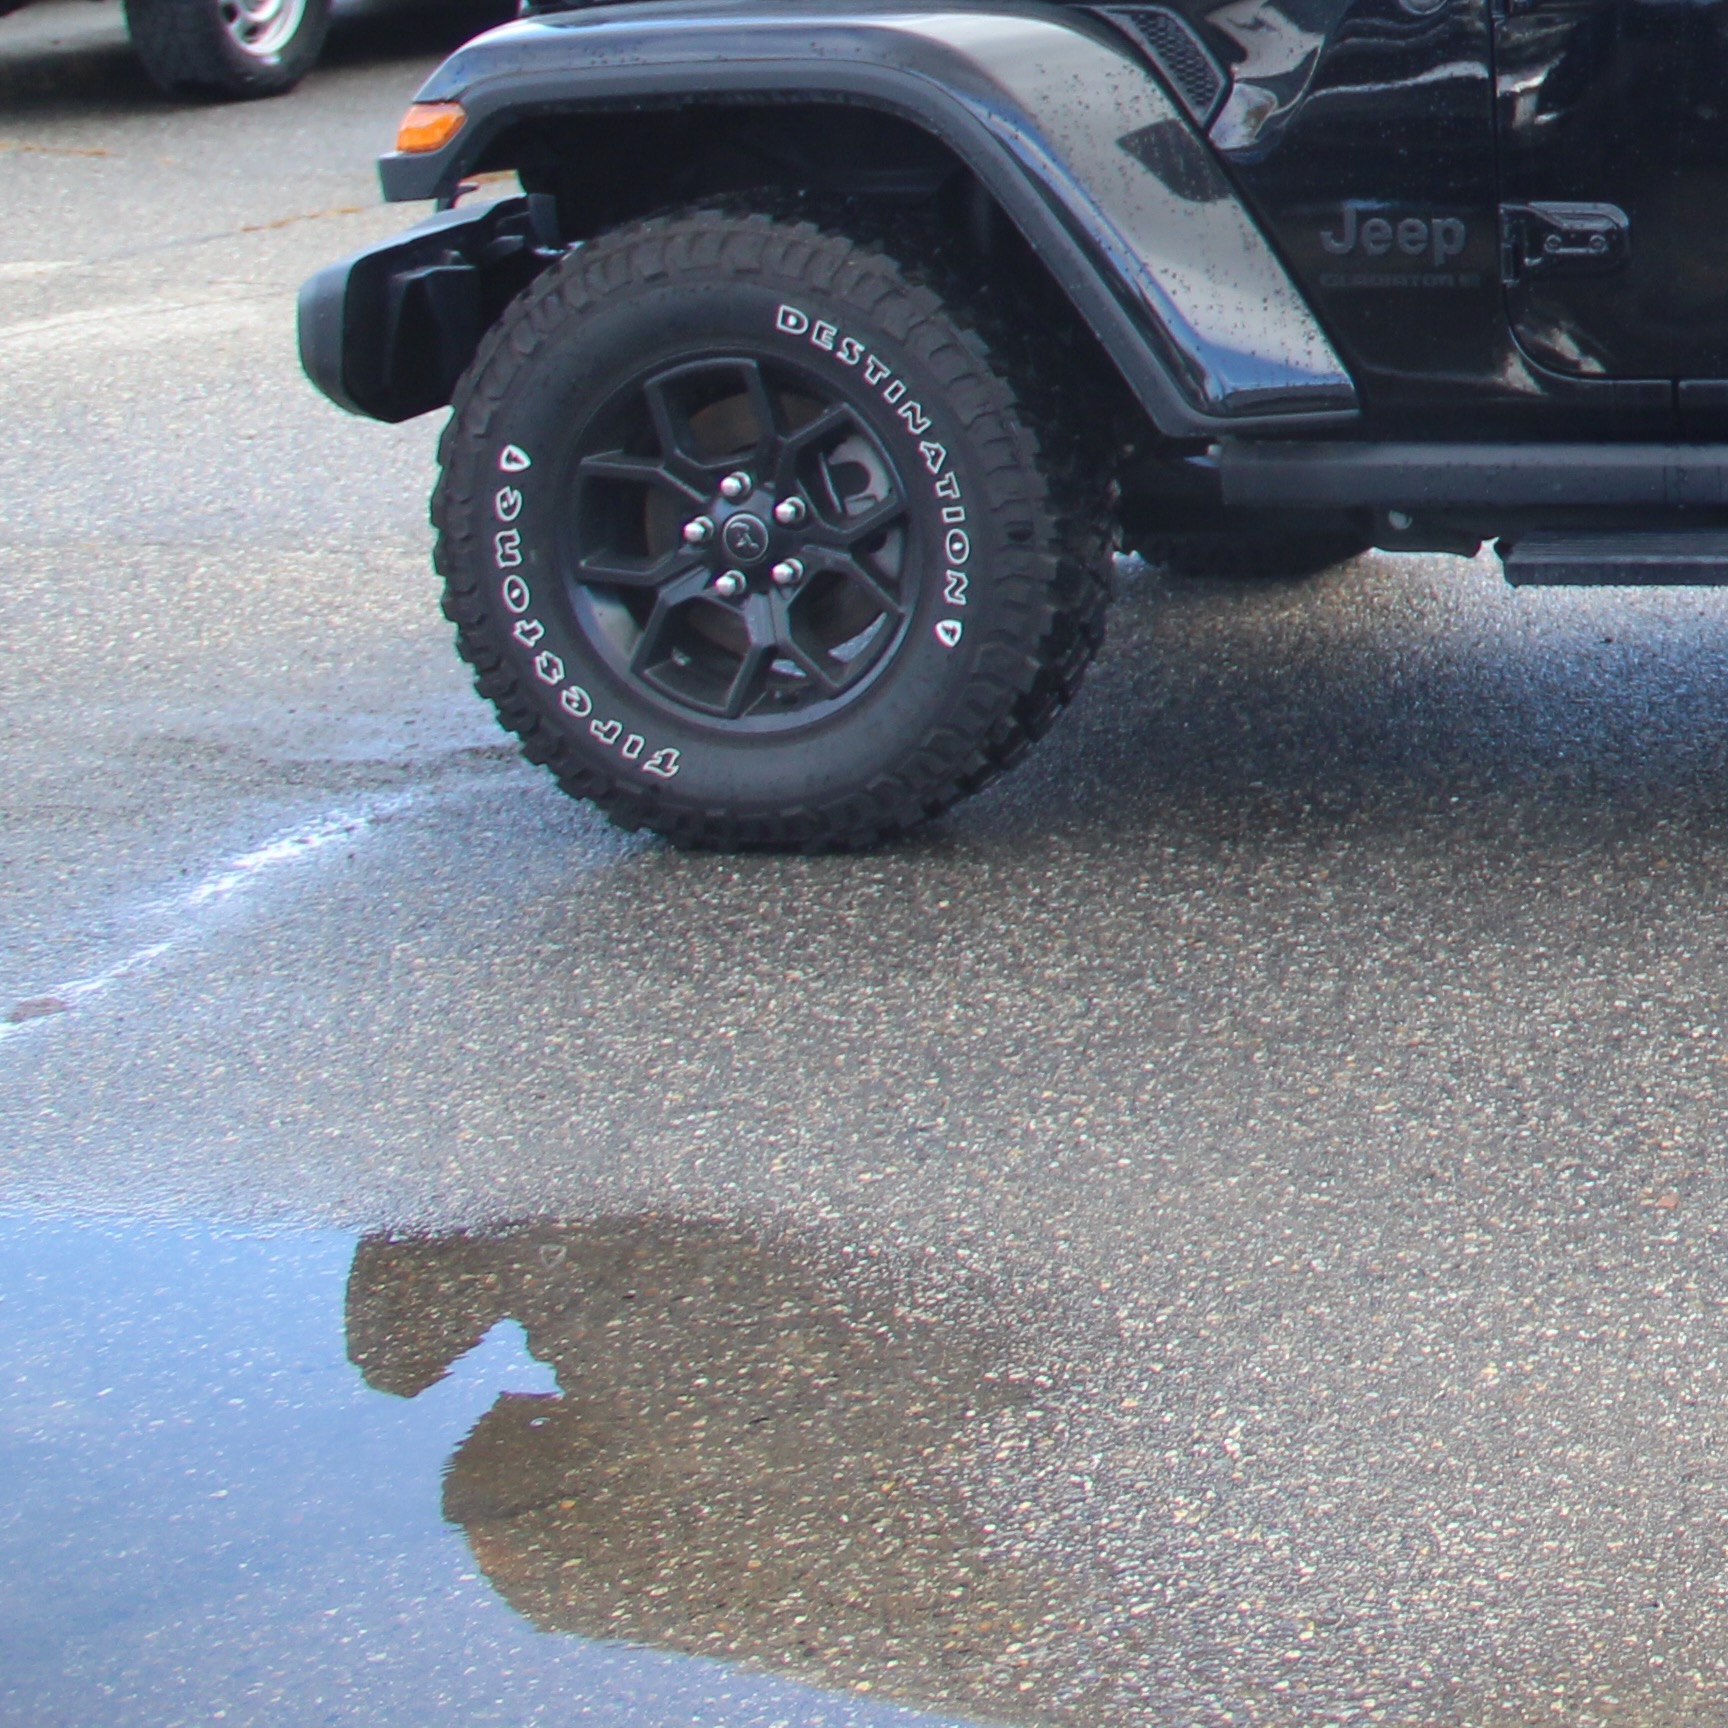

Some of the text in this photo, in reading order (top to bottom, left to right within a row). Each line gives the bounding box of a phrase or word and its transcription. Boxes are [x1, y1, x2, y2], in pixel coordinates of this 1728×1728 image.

[1319, 273, 1455, 288] GLADIATOR
[1320, 199, 1466, 267] Jeep
[777, 304, 969, 606] DESTINATION
[494, 485, 681, 778] Firestone
